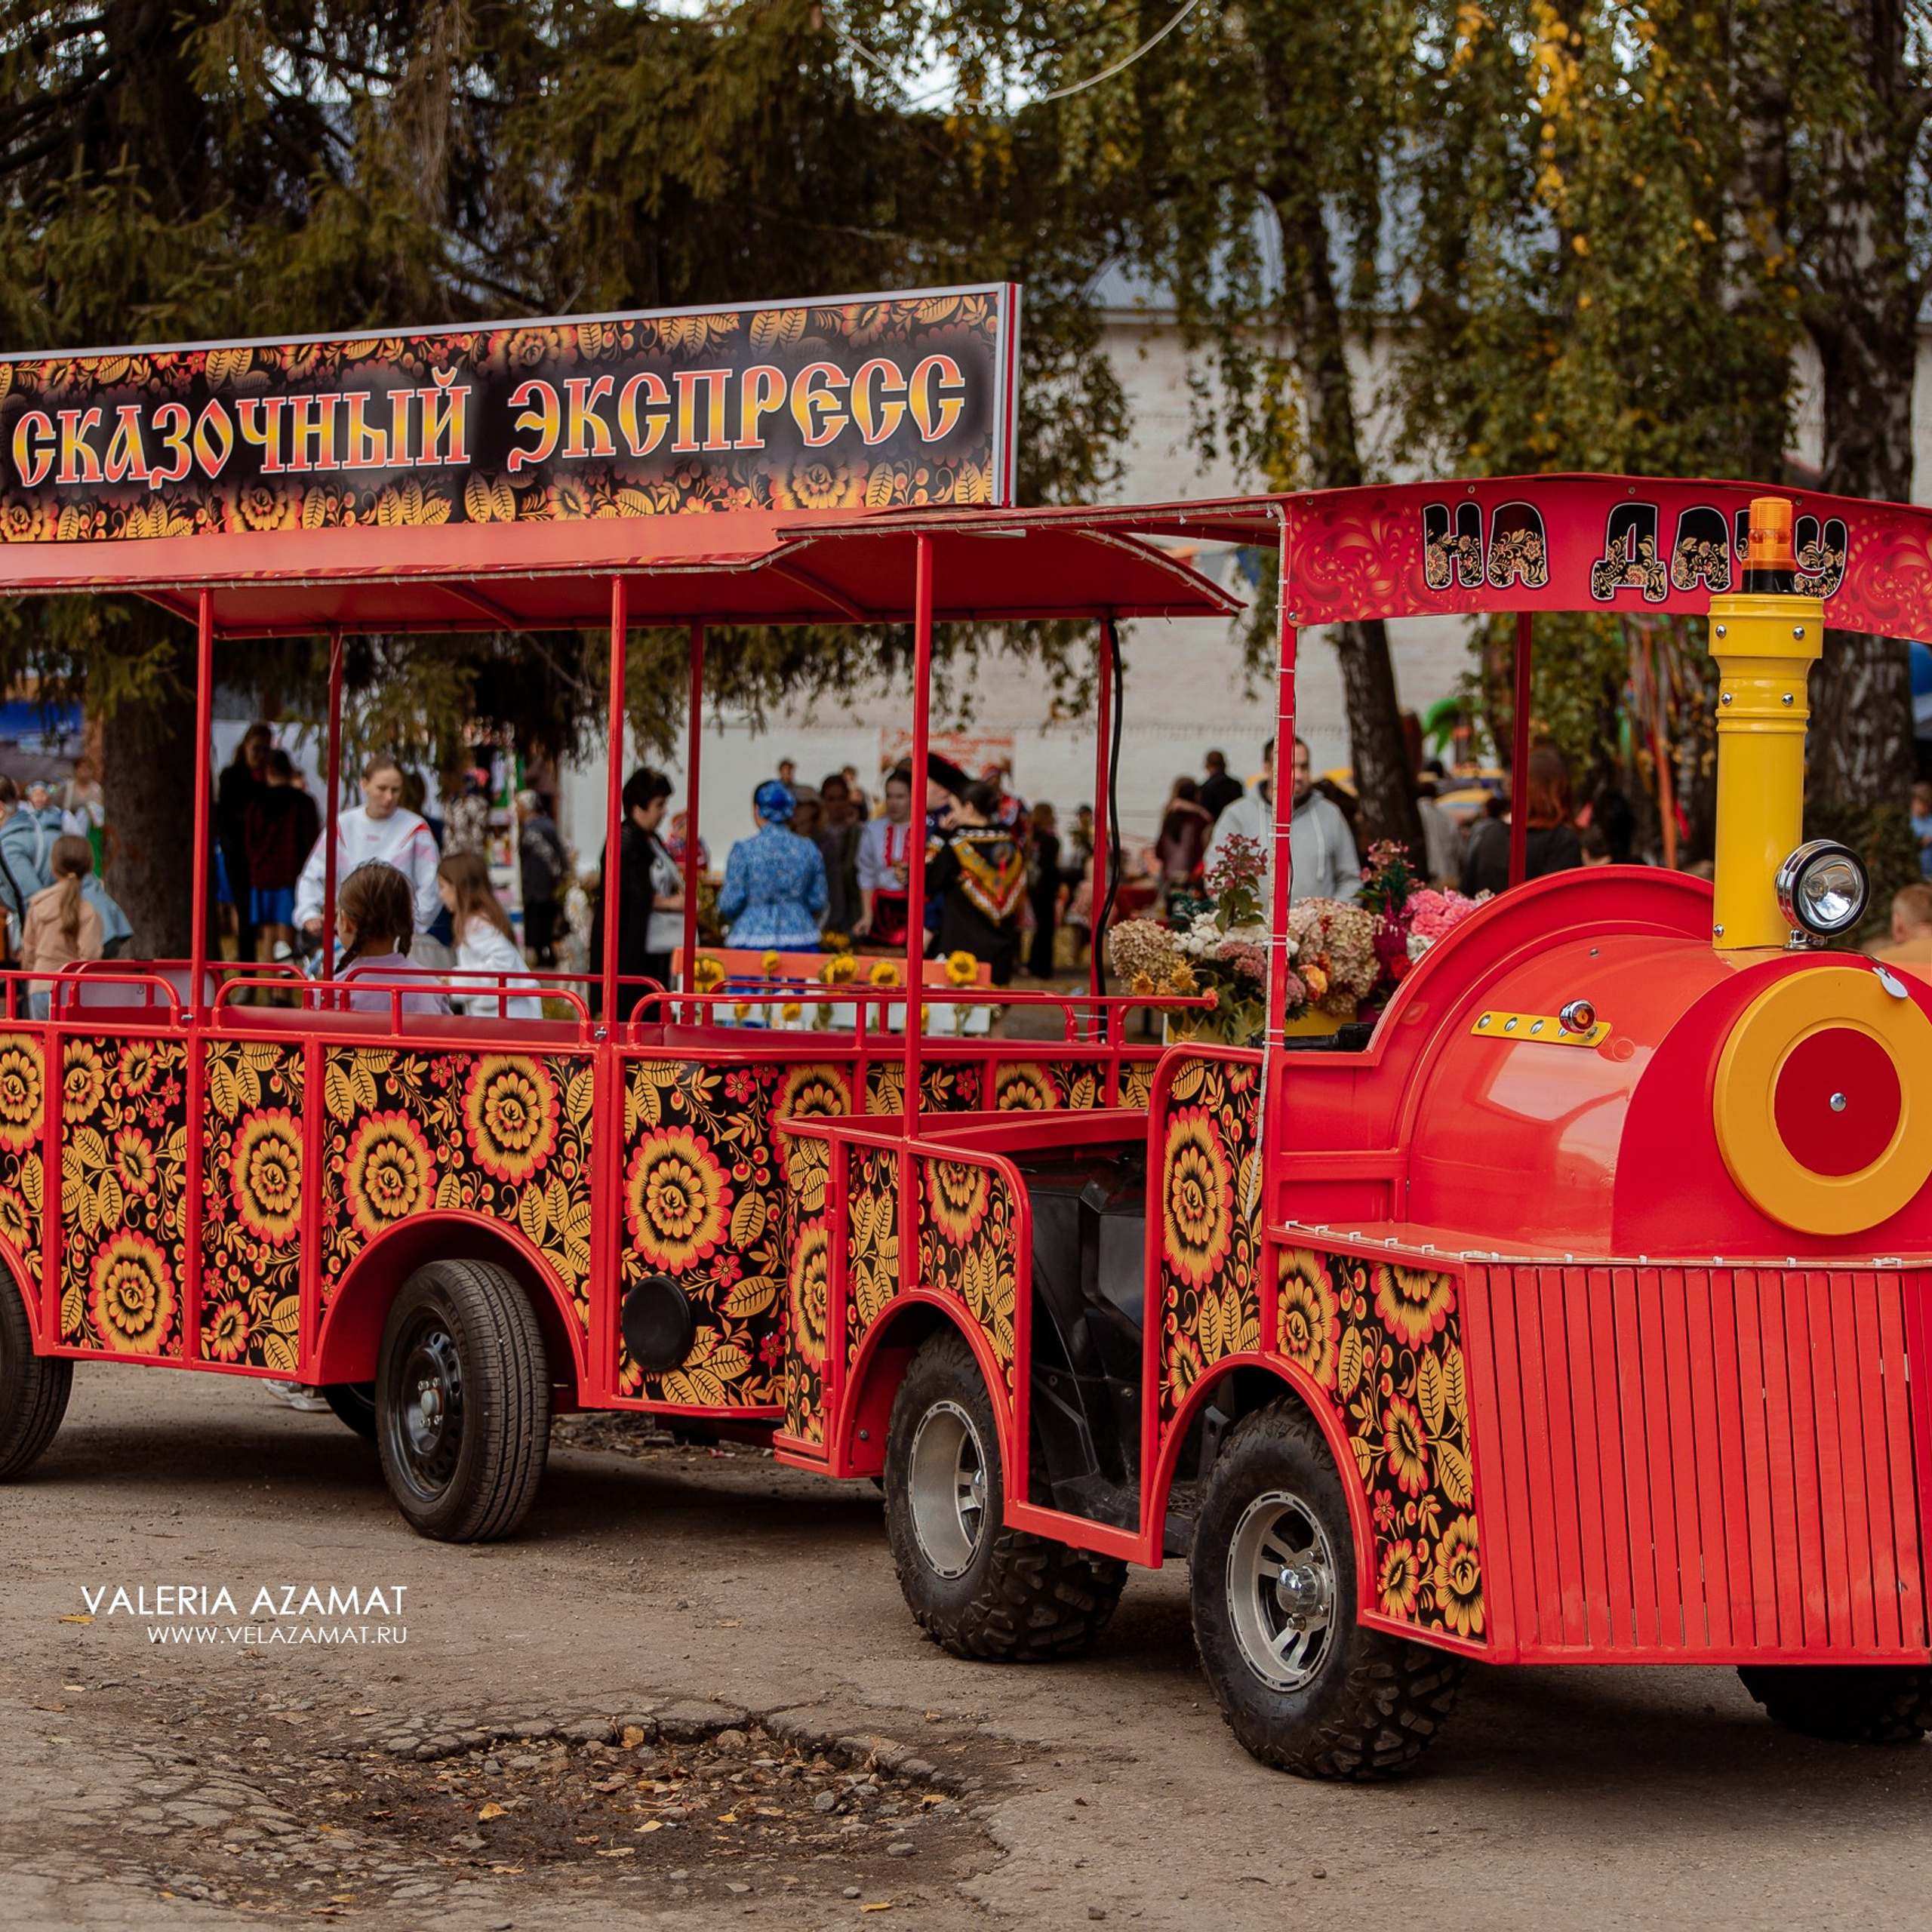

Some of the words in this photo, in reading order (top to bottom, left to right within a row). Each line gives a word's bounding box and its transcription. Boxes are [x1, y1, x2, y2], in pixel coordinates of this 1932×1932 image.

[12, 366, 472, 490] СКАЗОЧНЫЙ
[507, 353, 966, 472] ЭКСПРЕСС
[1423, 503, 1548, 589] НА
